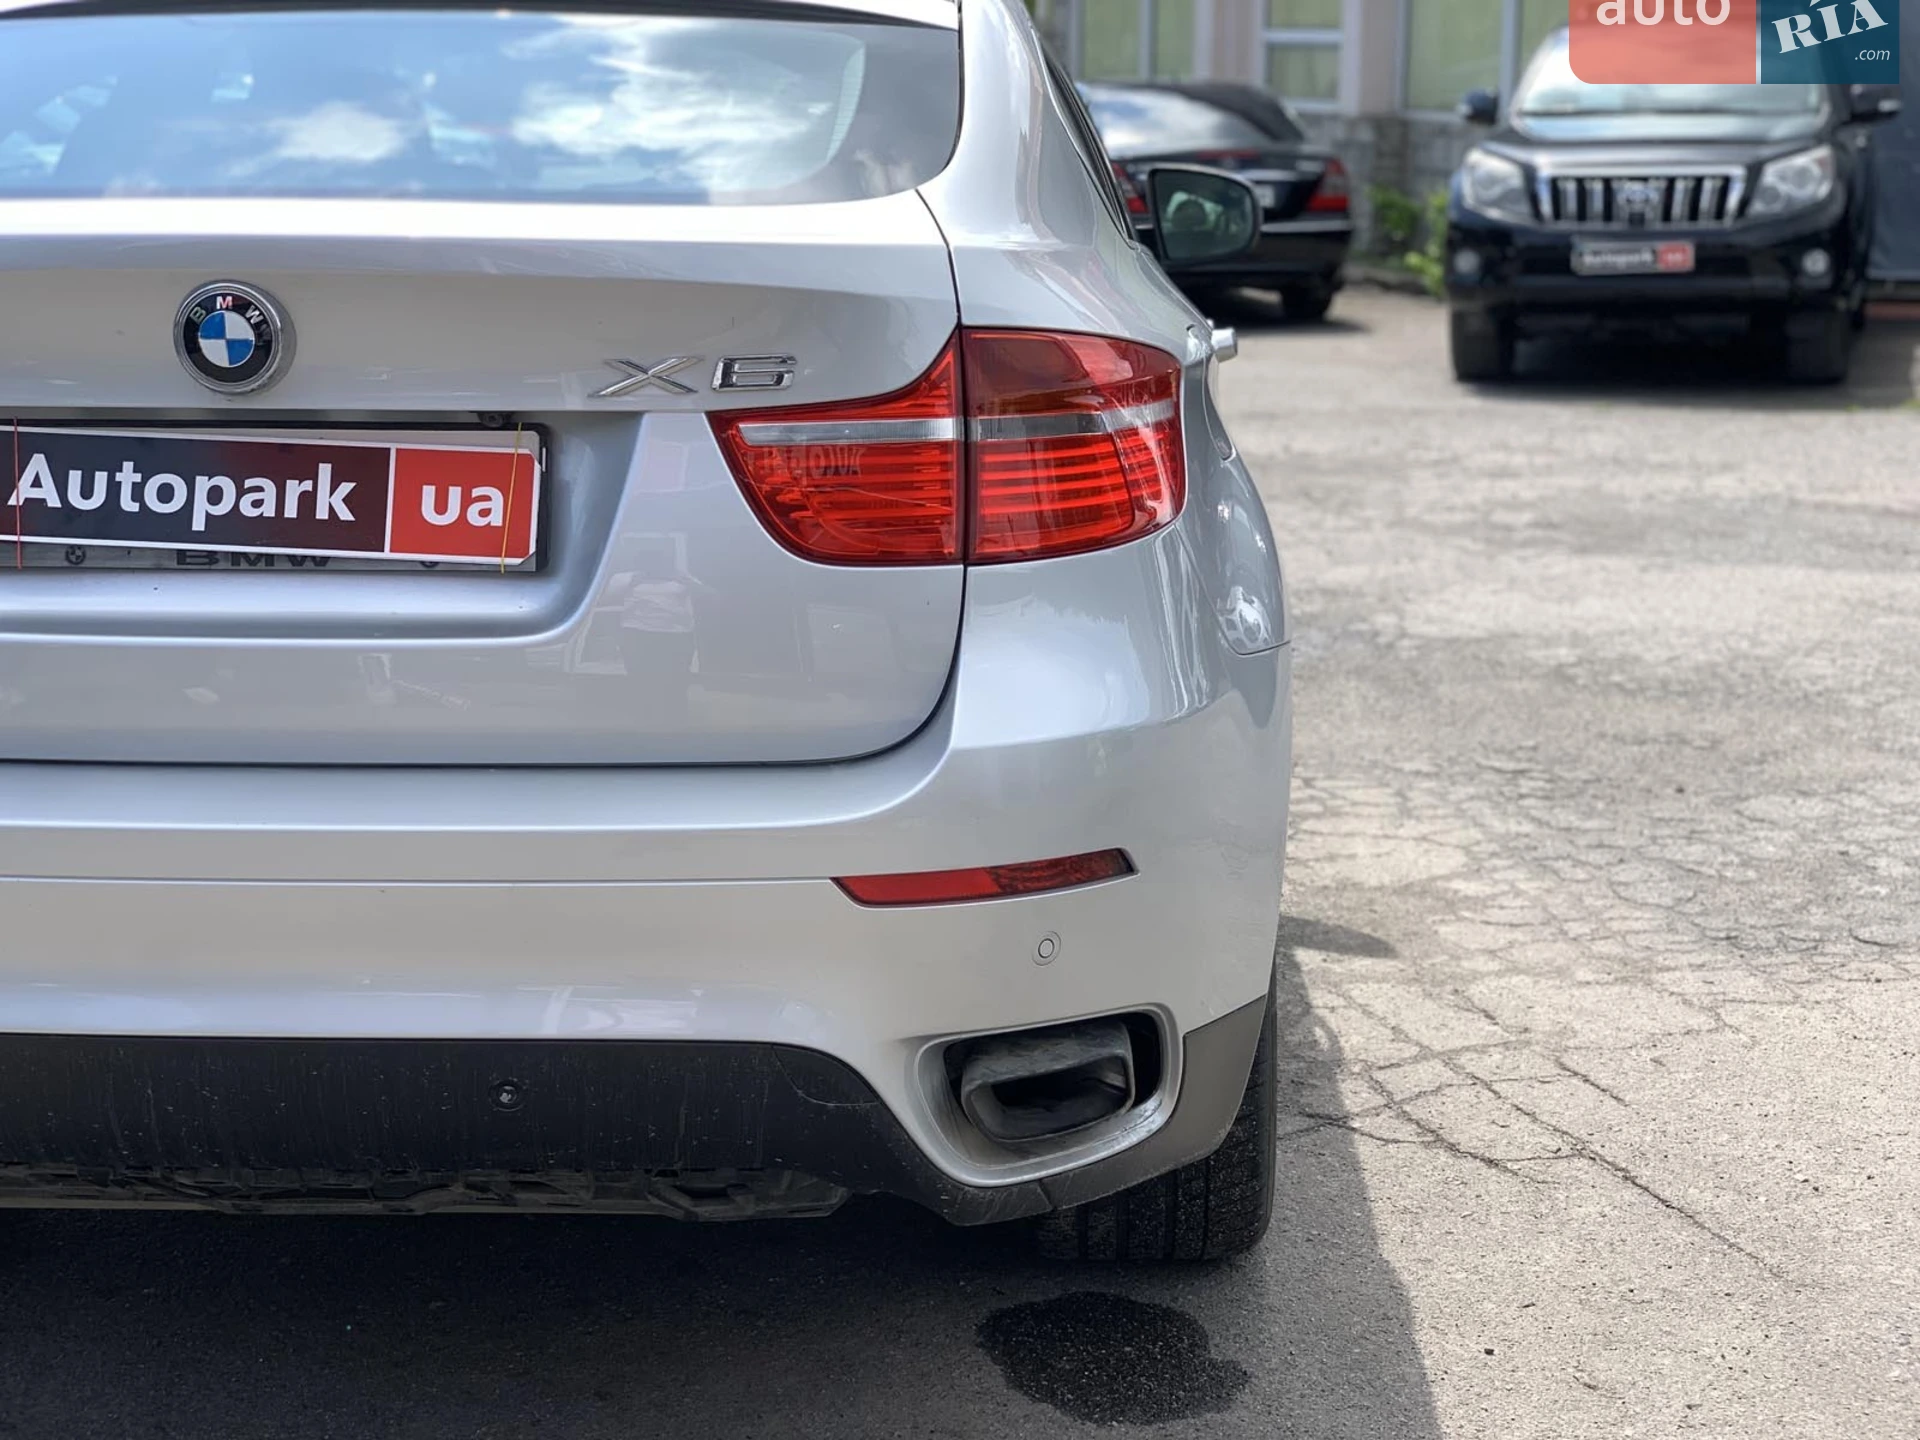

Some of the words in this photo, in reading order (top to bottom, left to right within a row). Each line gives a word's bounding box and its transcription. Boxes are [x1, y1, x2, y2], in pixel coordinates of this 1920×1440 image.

[189, 295, 265, 325] BMW
[9, 453, 358, 532] Autopark
[420, 483, 505, 527] ua
[176, 550, 332, 568] BMW
